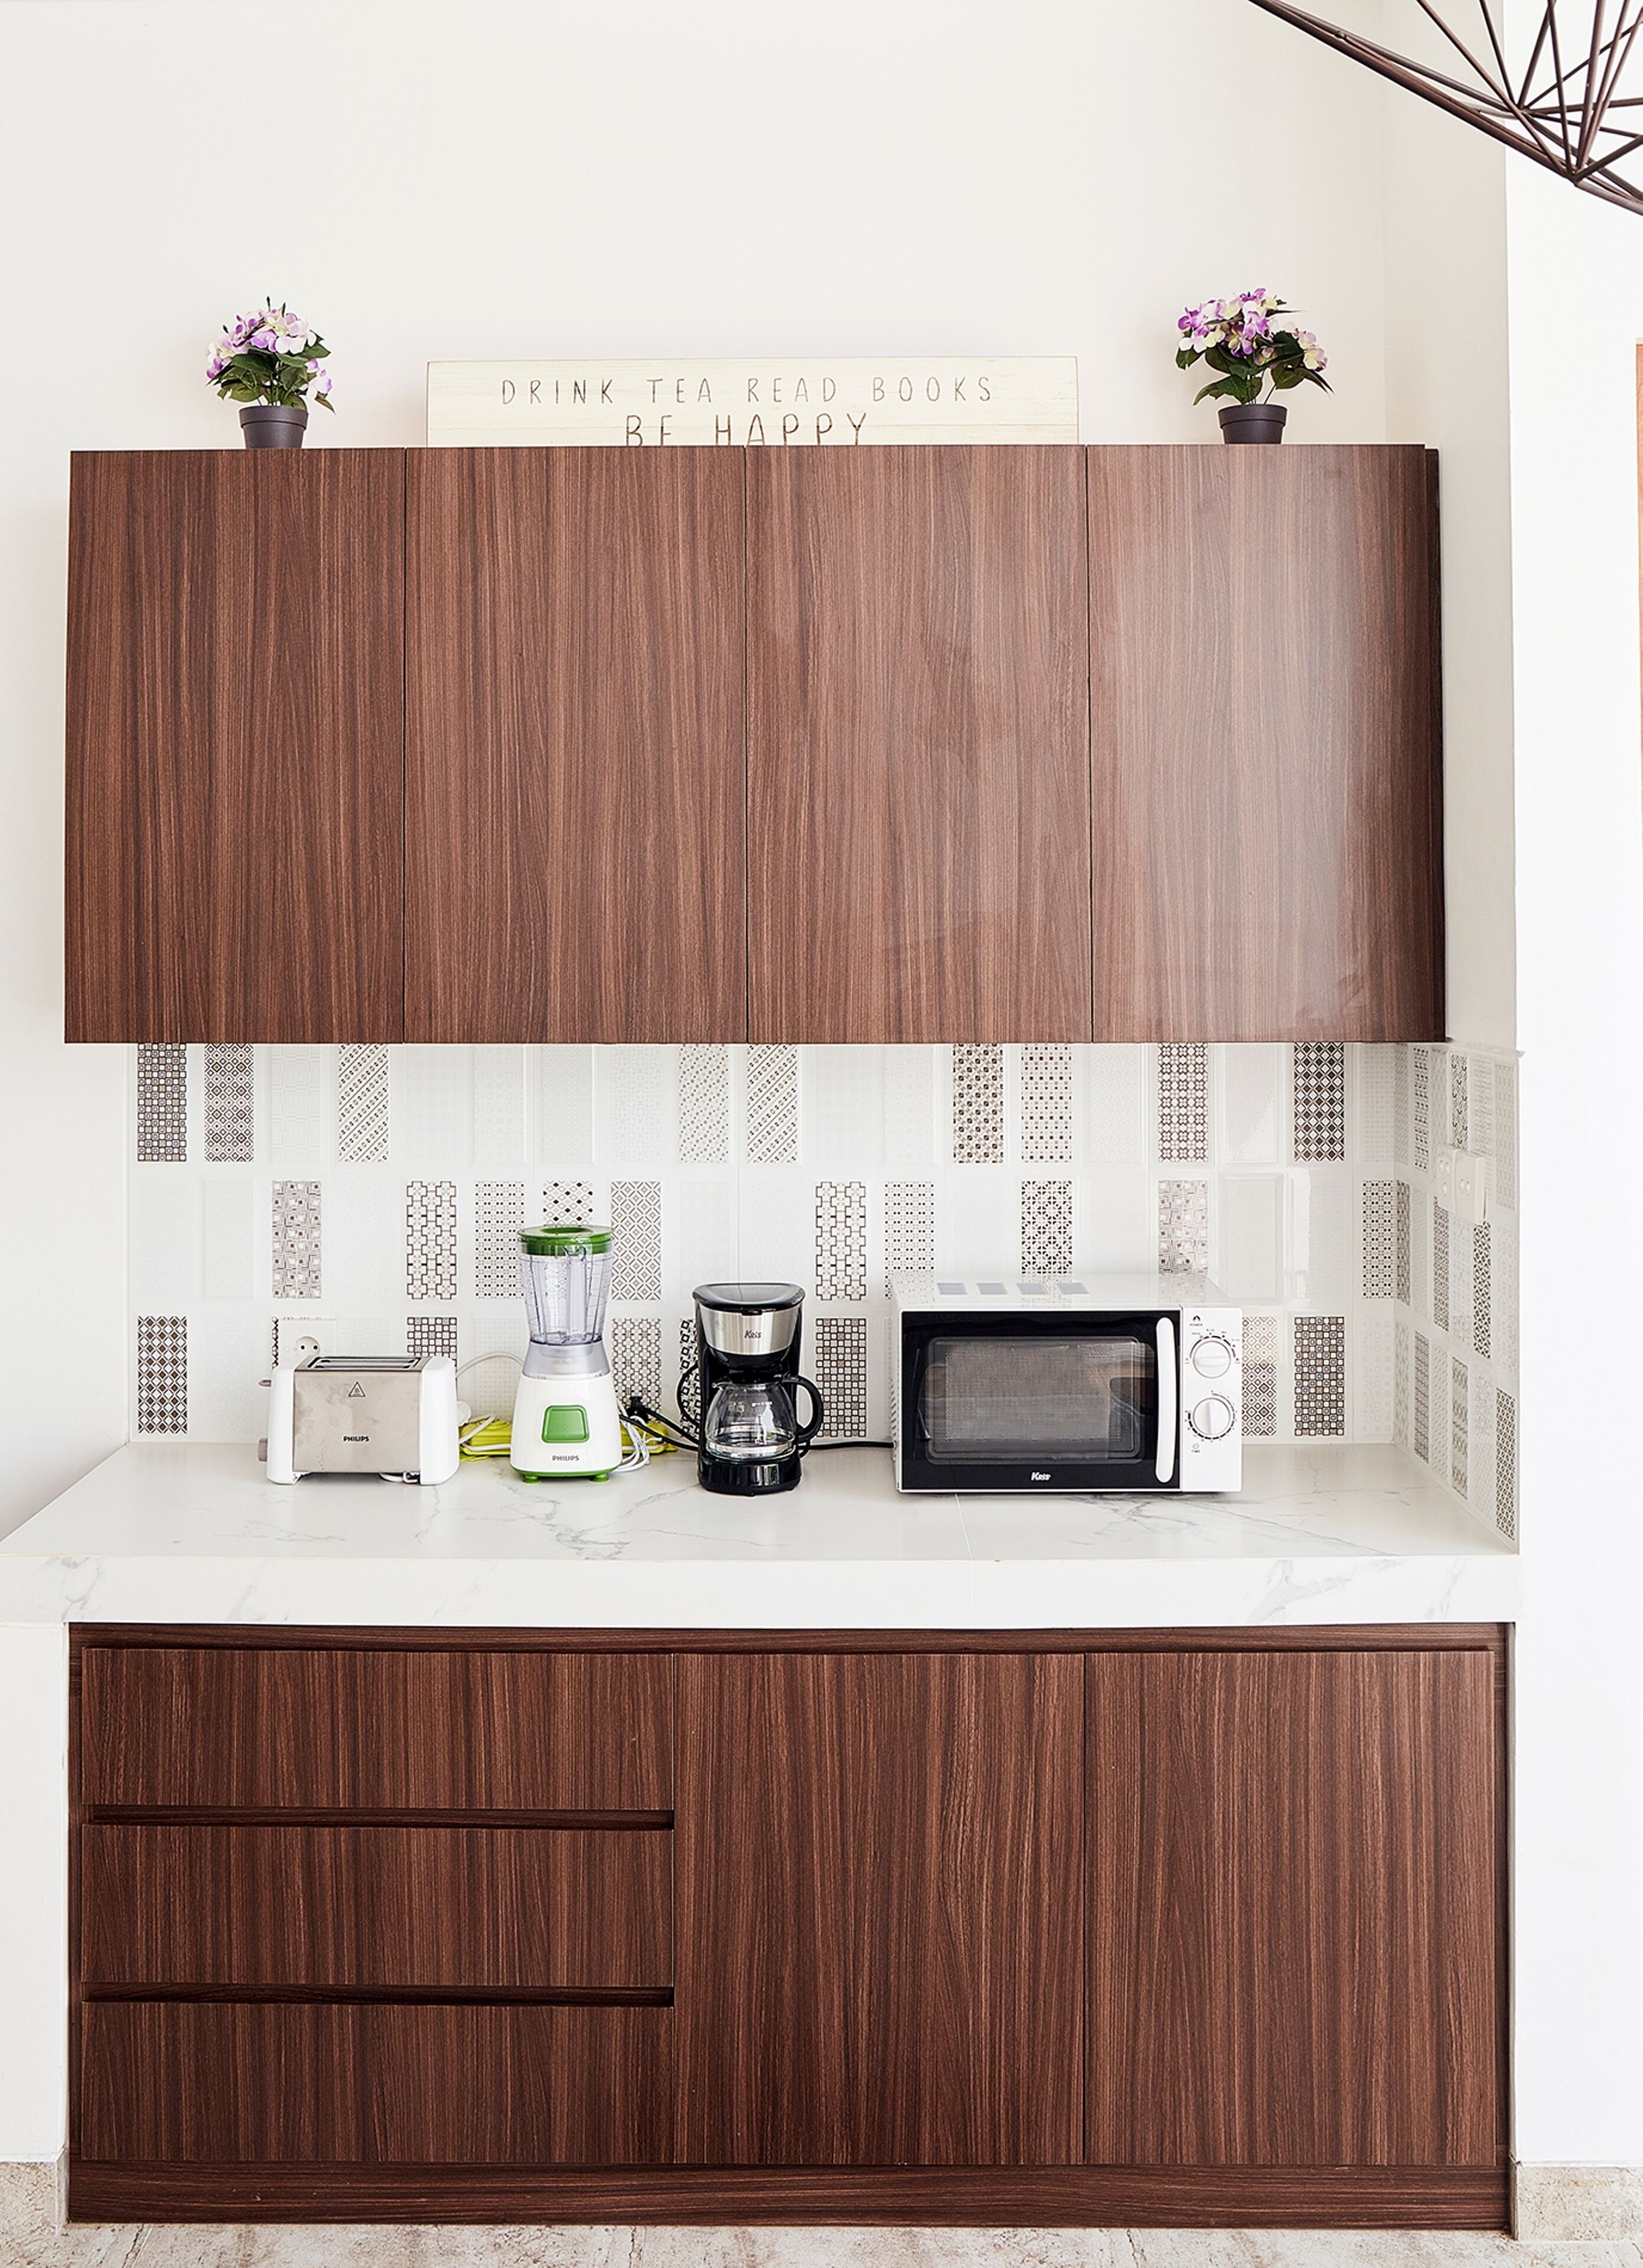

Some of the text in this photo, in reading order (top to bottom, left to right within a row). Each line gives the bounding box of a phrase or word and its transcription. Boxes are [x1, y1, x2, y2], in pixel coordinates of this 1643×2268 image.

[502, 376, 991, 405] DRINK TEA READ BOOKS
[715, 412, 866, 445] HAPPY
